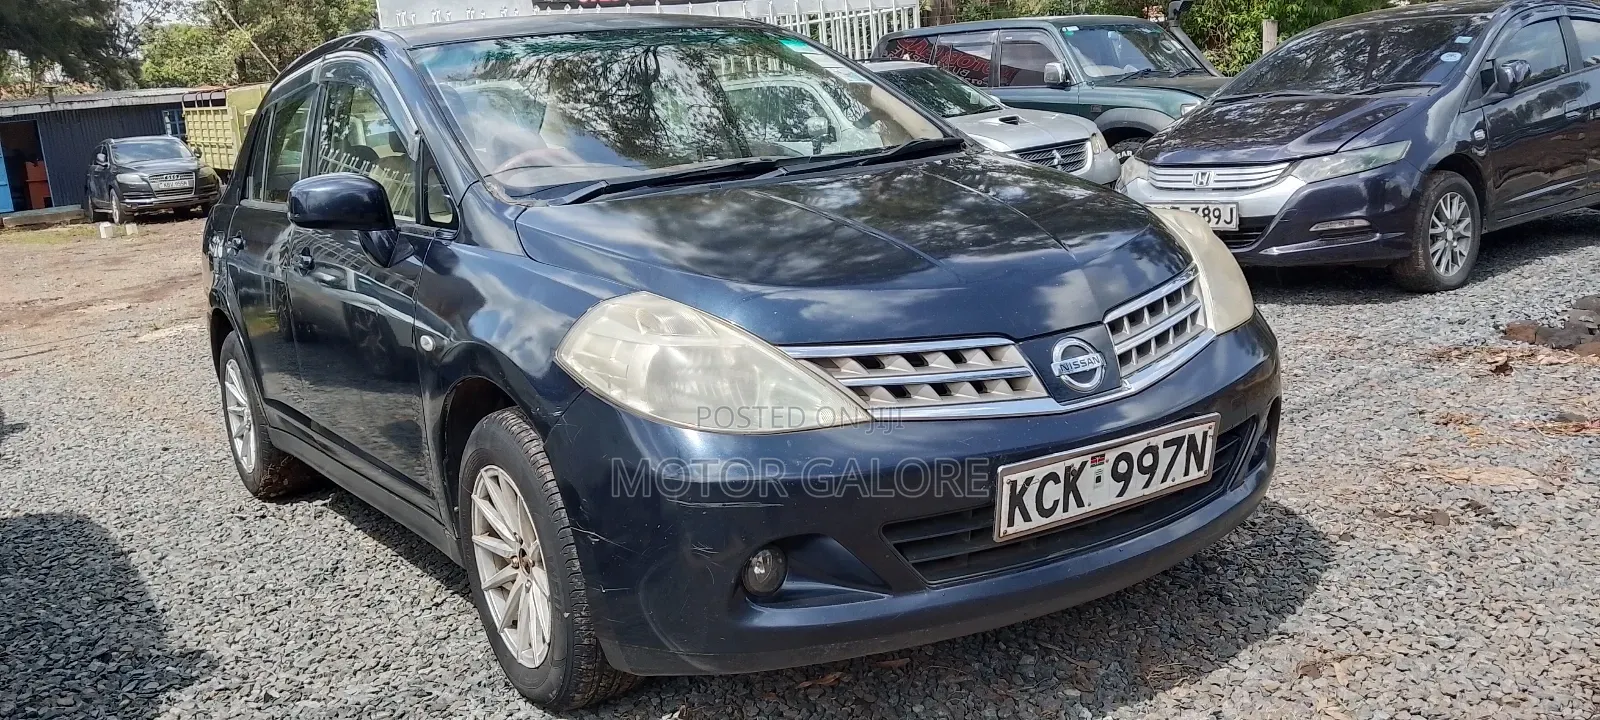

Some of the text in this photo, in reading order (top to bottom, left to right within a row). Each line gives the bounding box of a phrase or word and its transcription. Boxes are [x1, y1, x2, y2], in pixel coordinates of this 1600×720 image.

[1059, 355, 1100, 373] NISSAN
[1007, 430, 1209, 528] KCK 997N
